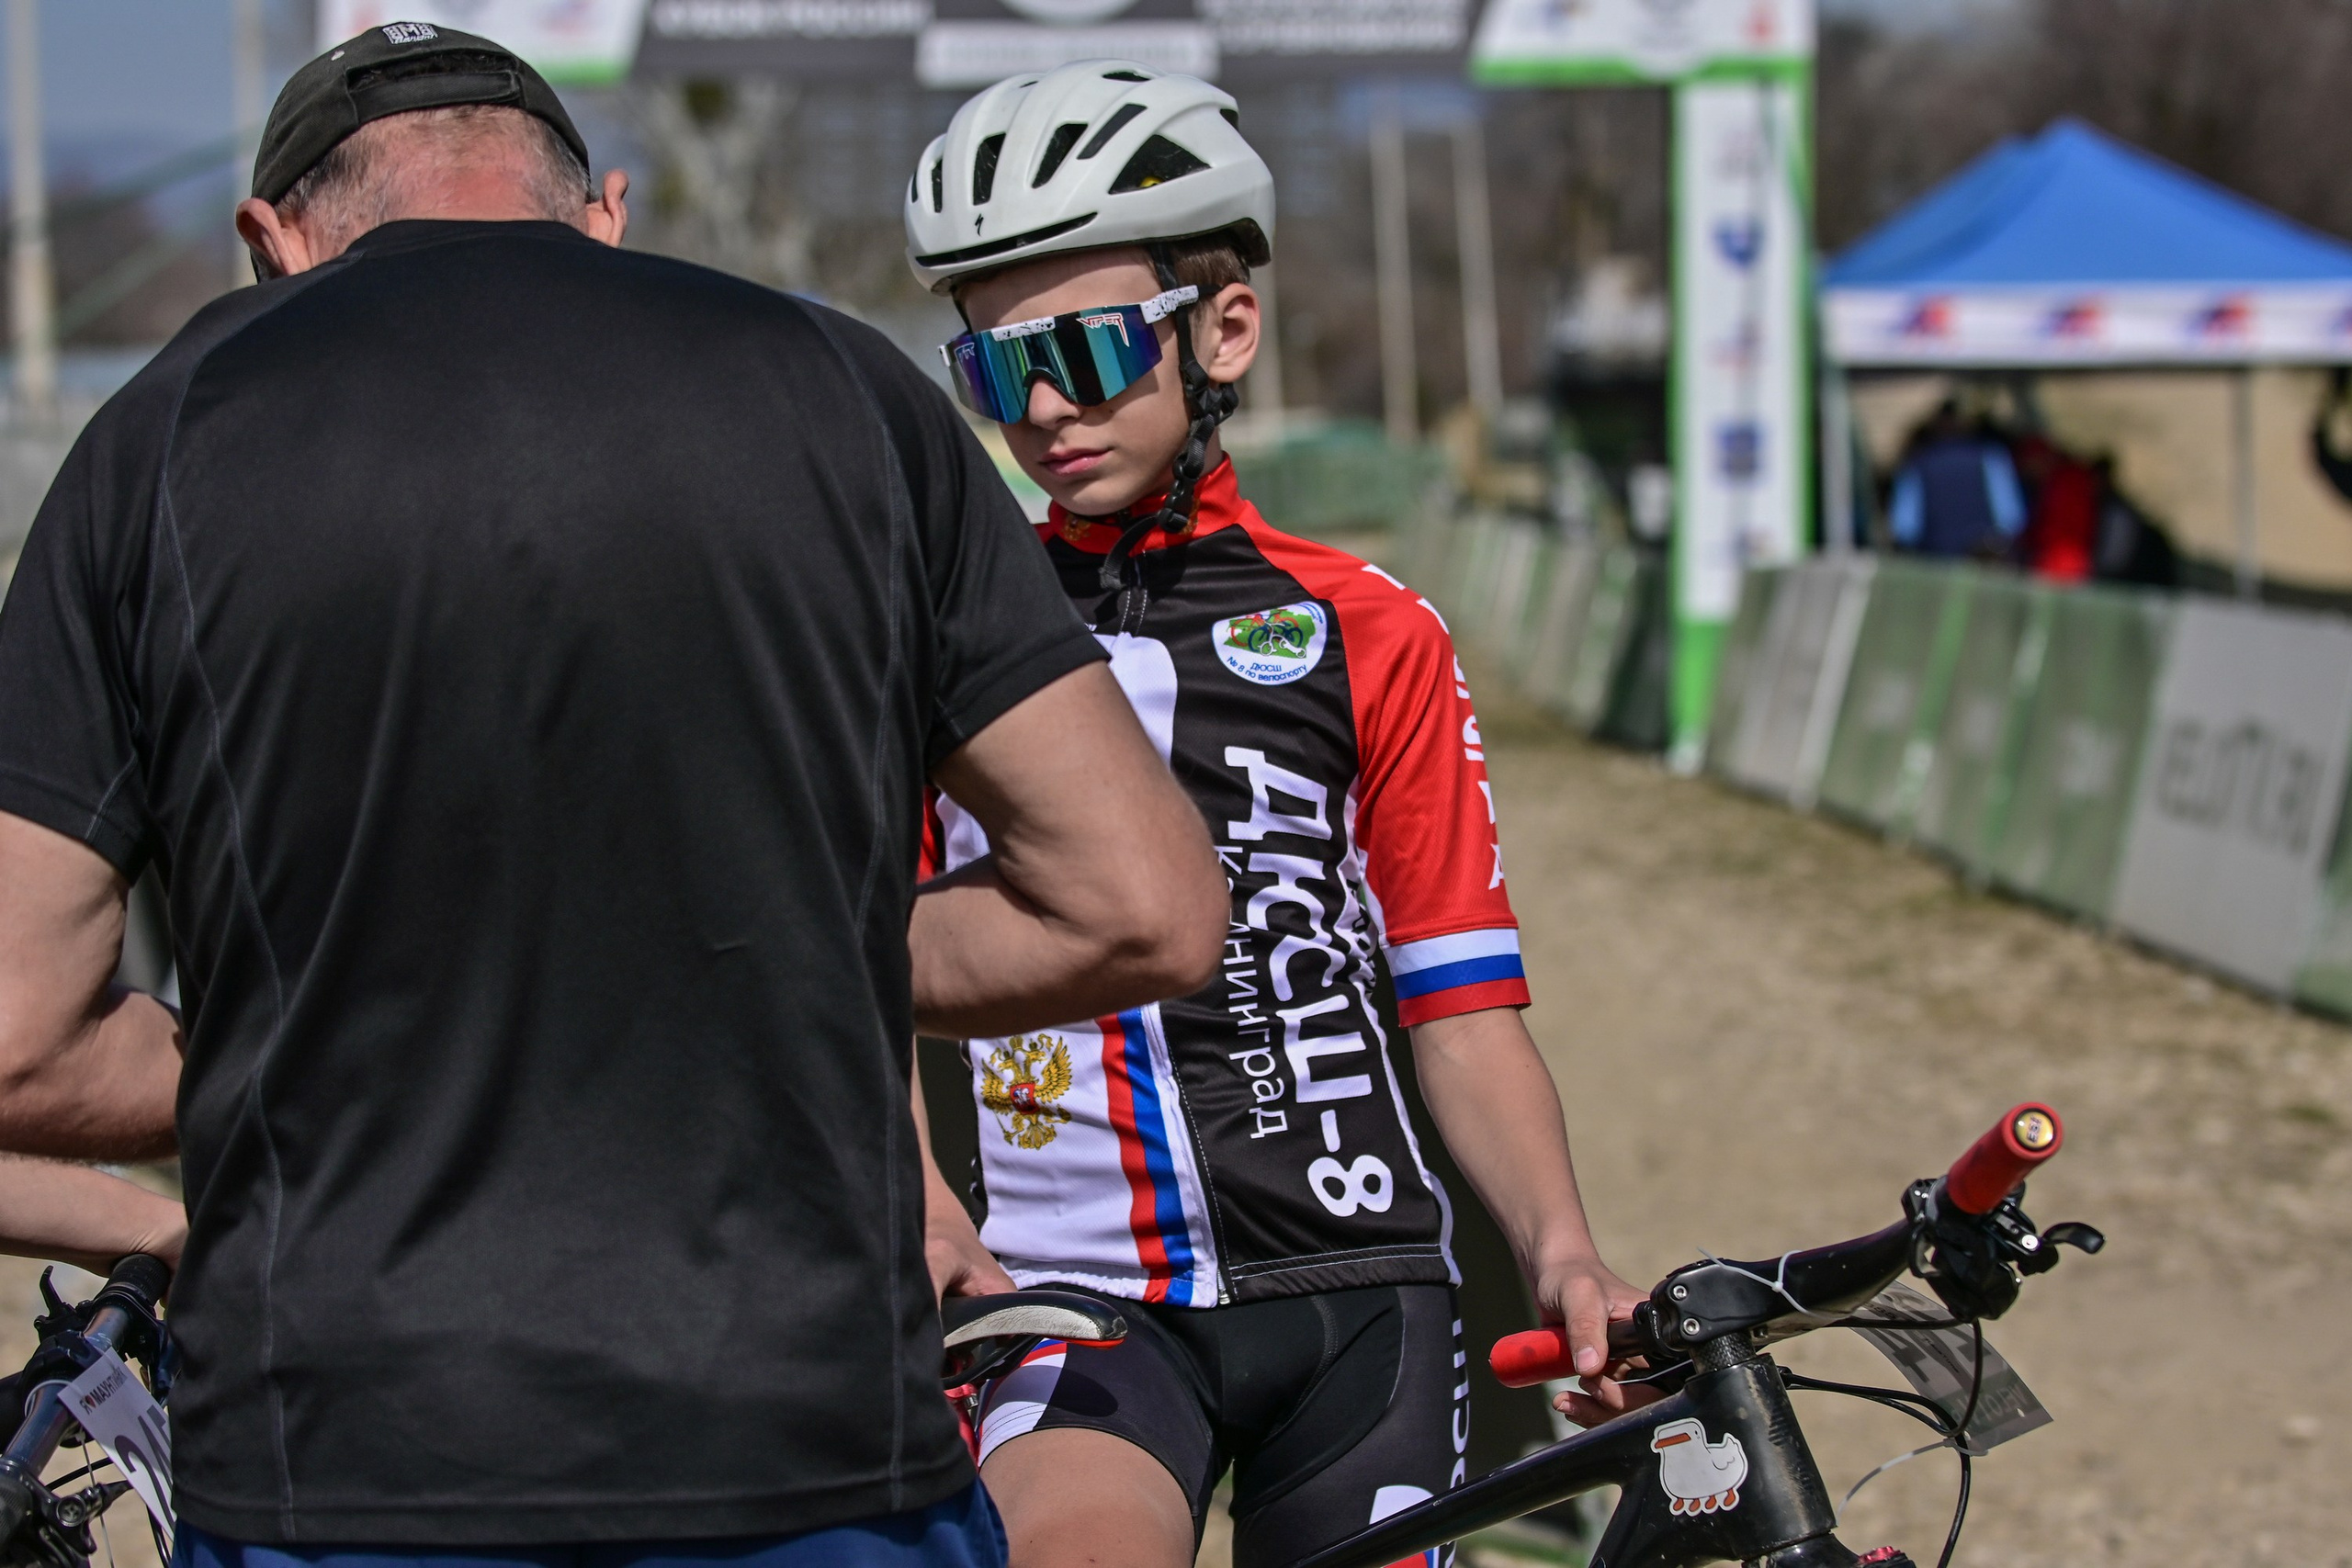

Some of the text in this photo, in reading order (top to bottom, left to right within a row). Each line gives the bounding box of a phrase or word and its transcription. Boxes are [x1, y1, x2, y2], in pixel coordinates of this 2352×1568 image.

[1238, 664, 1245, 672] 8
[1245, 669, 1256, 679] по
[1258, 663, 1308, 682] велоспорту
[1250, 662, 1283, 672] ДЮСШ
